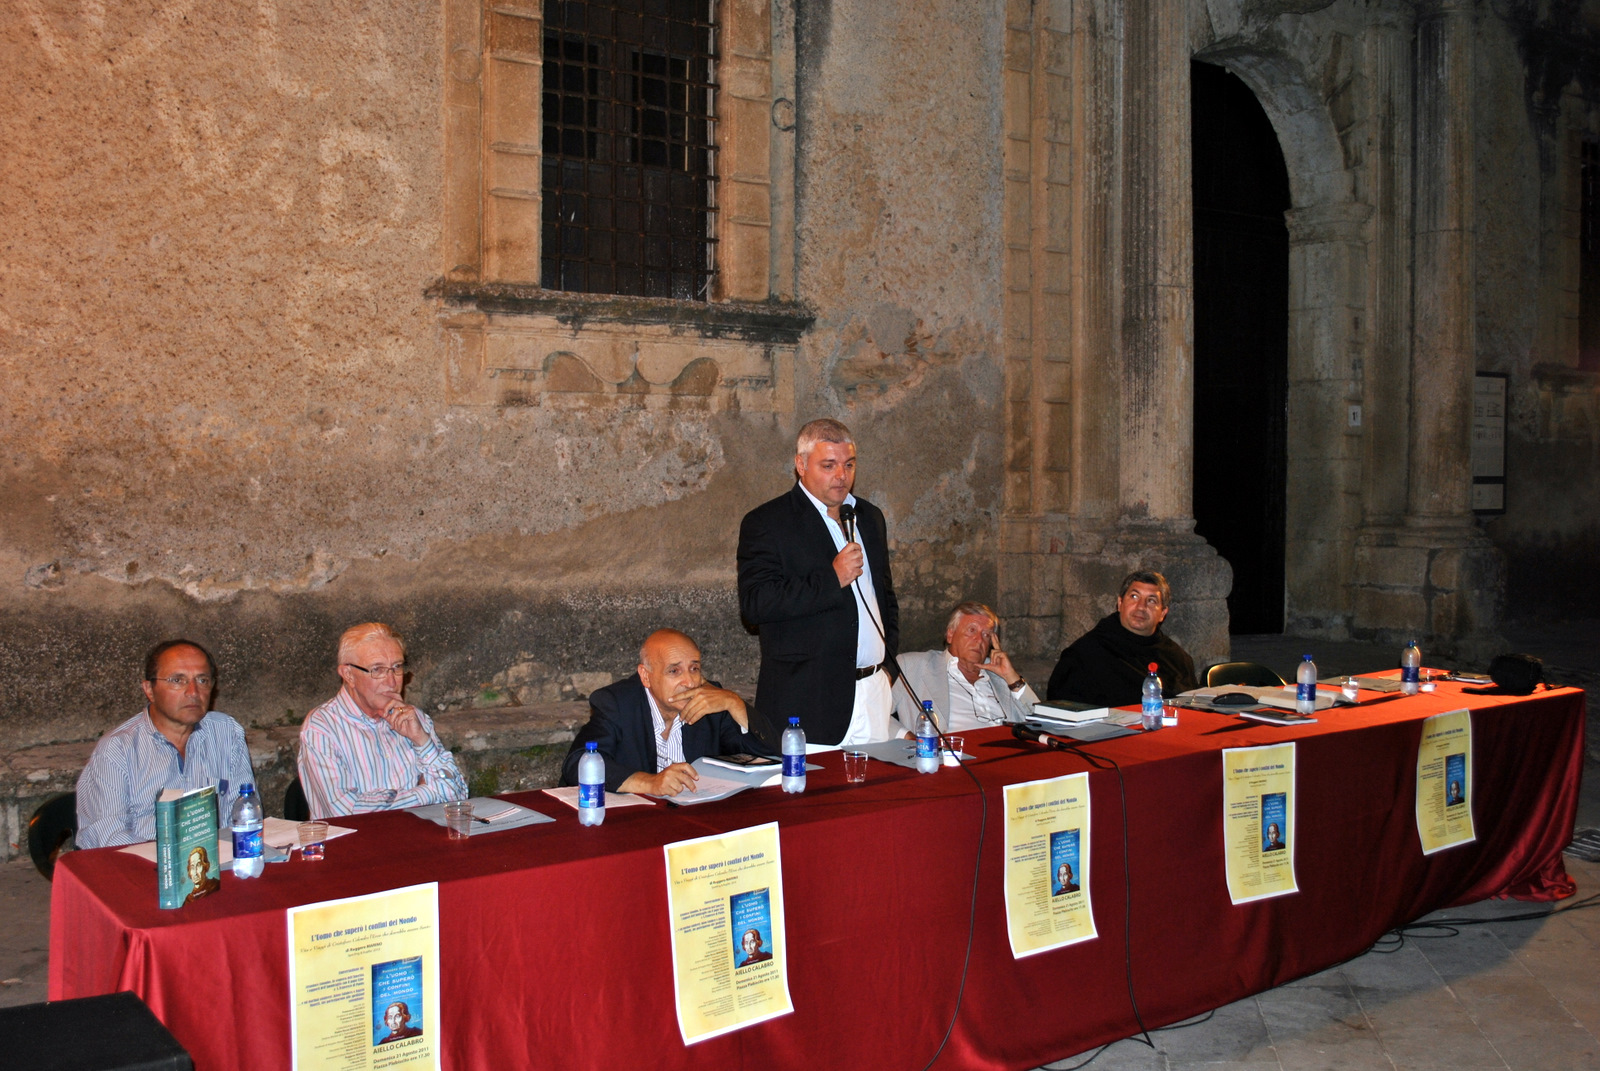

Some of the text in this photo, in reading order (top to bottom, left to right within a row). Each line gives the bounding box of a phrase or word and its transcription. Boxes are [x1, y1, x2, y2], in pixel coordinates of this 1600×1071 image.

[373, 1044, 394, 1054] AIELLO
[396, 1038, 424, 1048] CALABRO
[373, 1055, 396, 1064] Domenica
[402, 1050, 418, 1058] Agosto
[388, 1058, 409, 1066] Plebiscito
